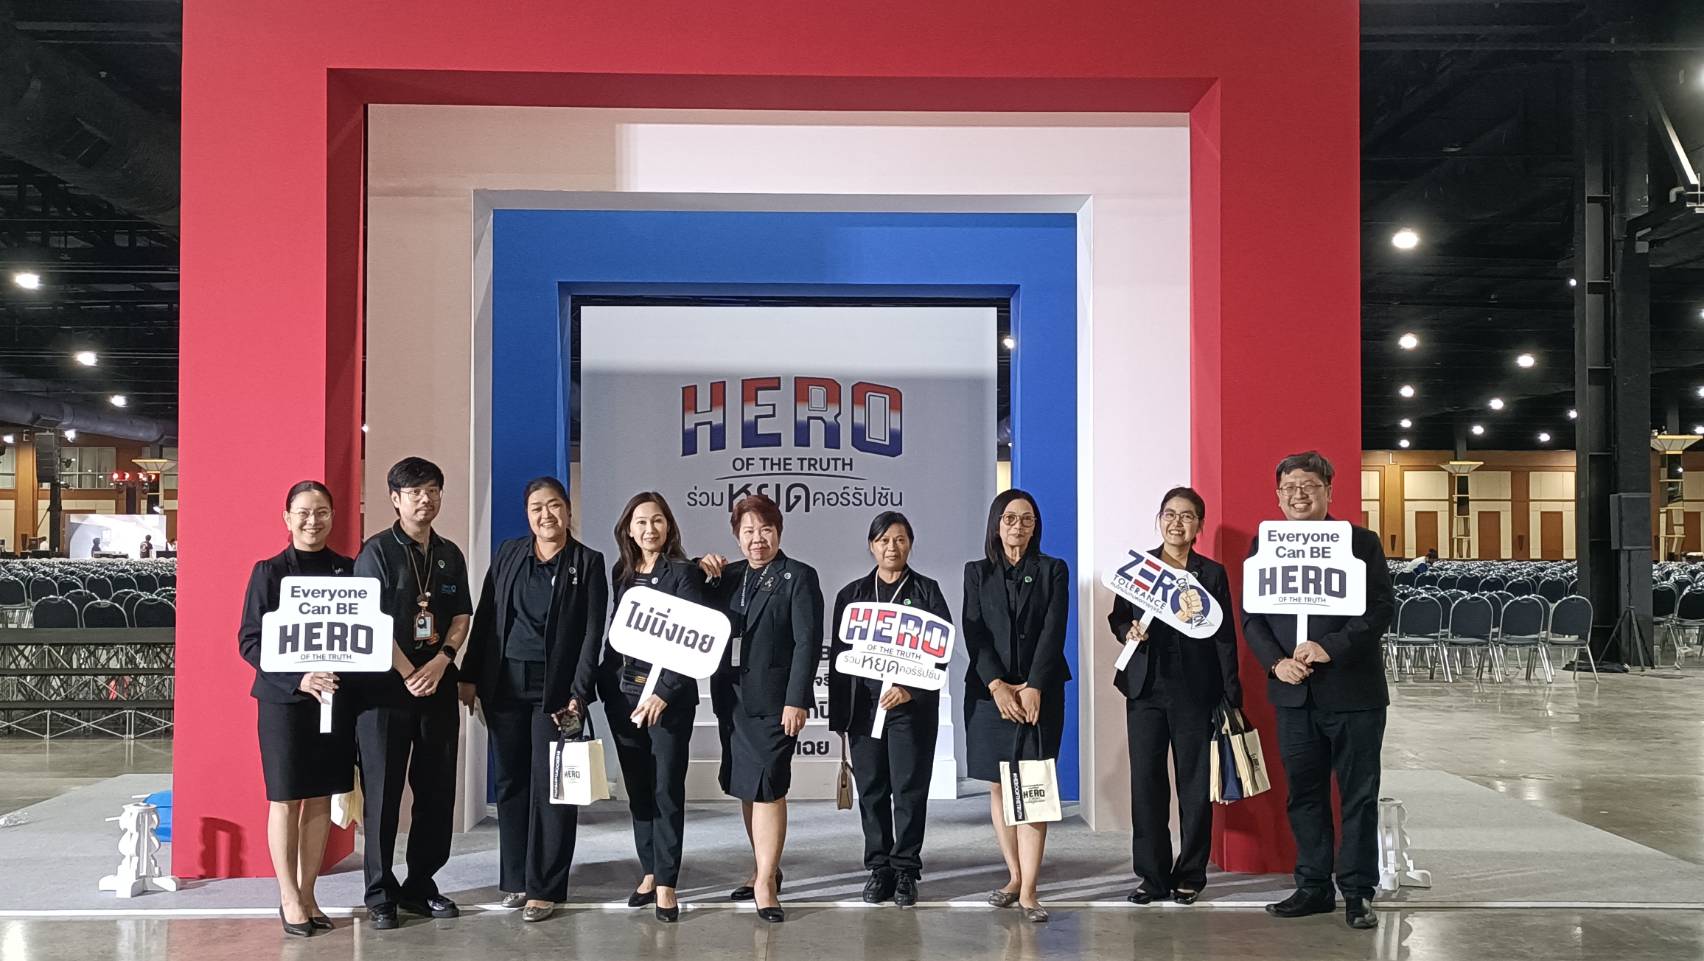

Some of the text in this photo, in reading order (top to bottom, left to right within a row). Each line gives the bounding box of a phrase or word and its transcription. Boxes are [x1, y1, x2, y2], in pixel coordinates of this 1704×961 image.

[681, 376, 903, 457] HERO
[732, 457, 853, 472] OF THE TRUTH
[1267, 529, 1340, 546] Everyone
[1275, 545, 1332, 559] Can BE
[1116, 549, 1211, 625] ZERO
[1258, 565, 1347, 599] HERO
[290, 585, 368, 602] Everyone
[1112, 574, 1168, 611] TOLERANCE
[1304, 596, 1327, 604] TRUTH
[298, 602, 359, 615] Can BE
[625, 600, 716, 654] ไม่นิ่งเฉย
[845, 608, 950, 658] HERO
[278, 622, 374, 654] HERO
[866, 643, 922, 661] OF THE TRUTH
[1023, 789, 1045, 798] HERO
